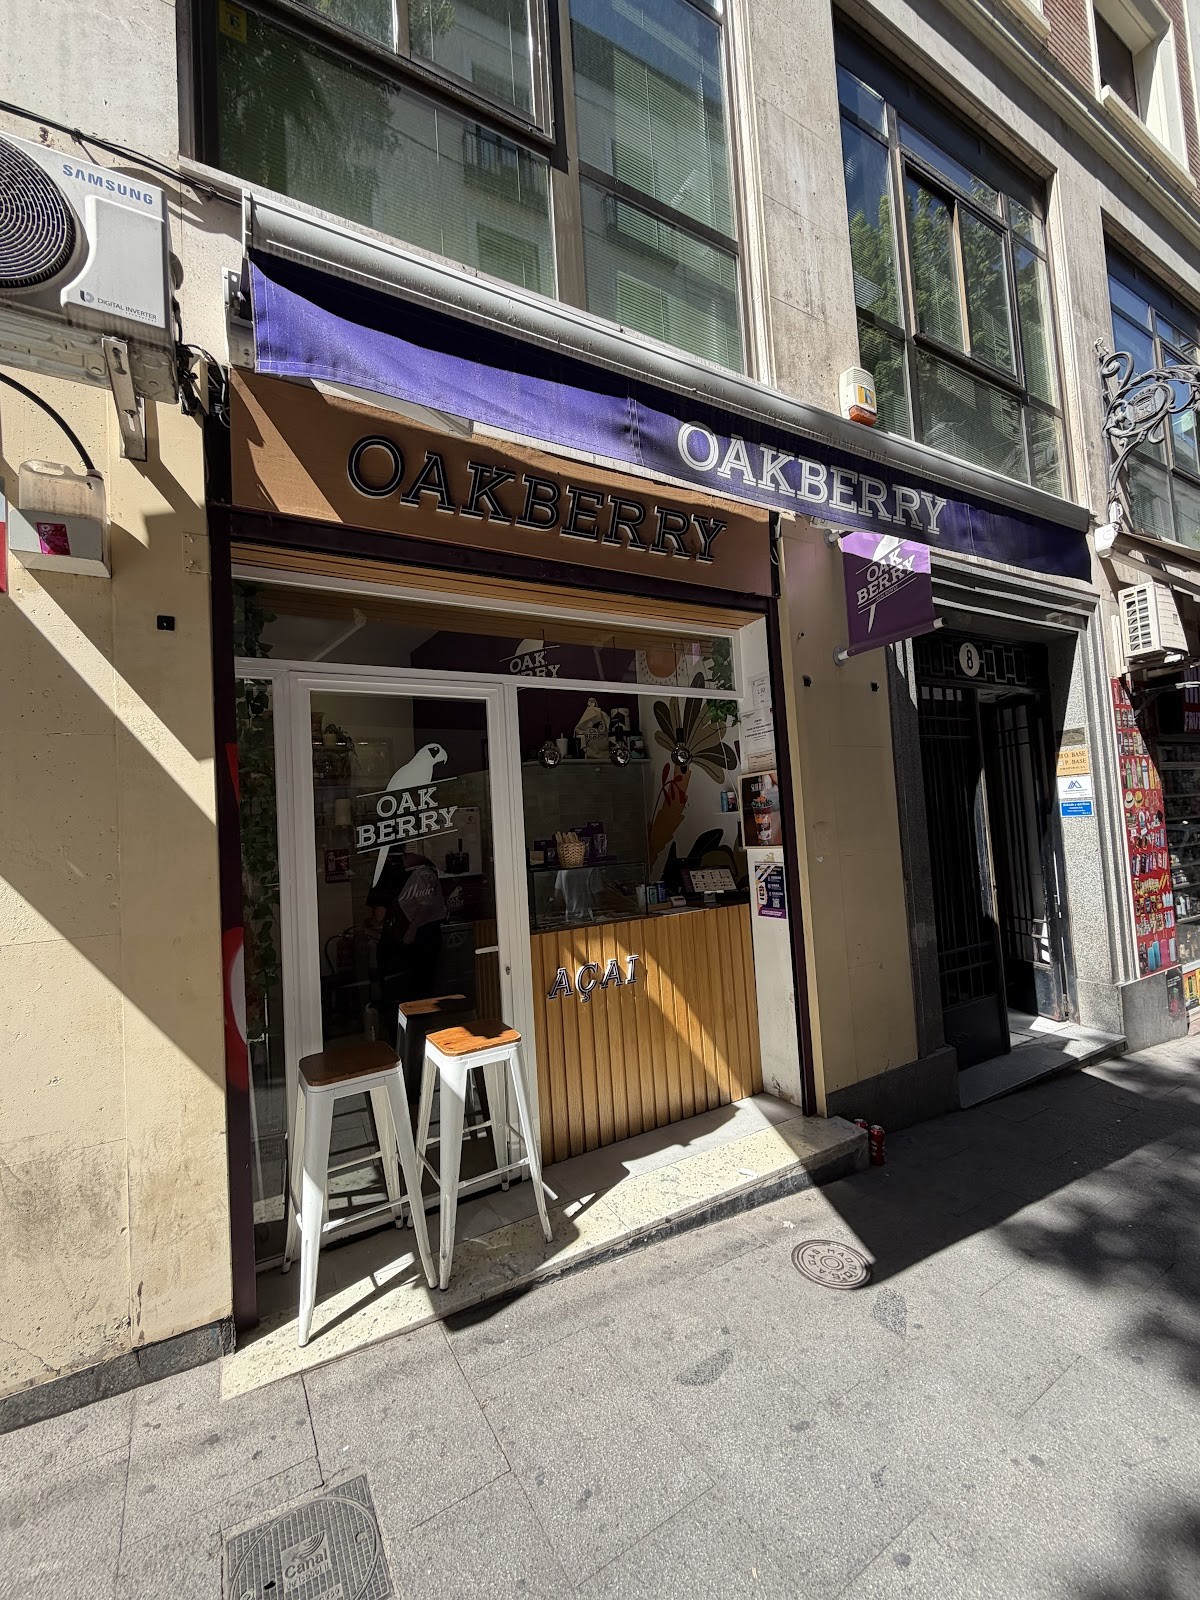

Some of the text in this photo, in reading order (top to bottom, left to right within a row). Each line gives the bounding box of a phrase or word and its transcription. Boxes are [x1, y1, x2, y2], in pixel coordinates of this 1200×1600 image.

[62, 164, 154, 205] SAMSUNG
[97, 297, 125, 312] DIGITAL
[125, 305, 157, 320] INVERTER
[677, 421, 947, 535] OAKBERRY
[346, 434, 728, 564] OAKBERRY
[856, 554, 916, 606] BERRY
[866, 547, 903, 582] OAK
[509, 651, 548, 673] OAK
[966, 649, 974, 670] 8
[376, 786, 439, 818] OAK
[356, 805, 458, 849] BERRY
[807, 1248, 821, 1266] GAS
[284, 1548, 328, 1579] Canal
